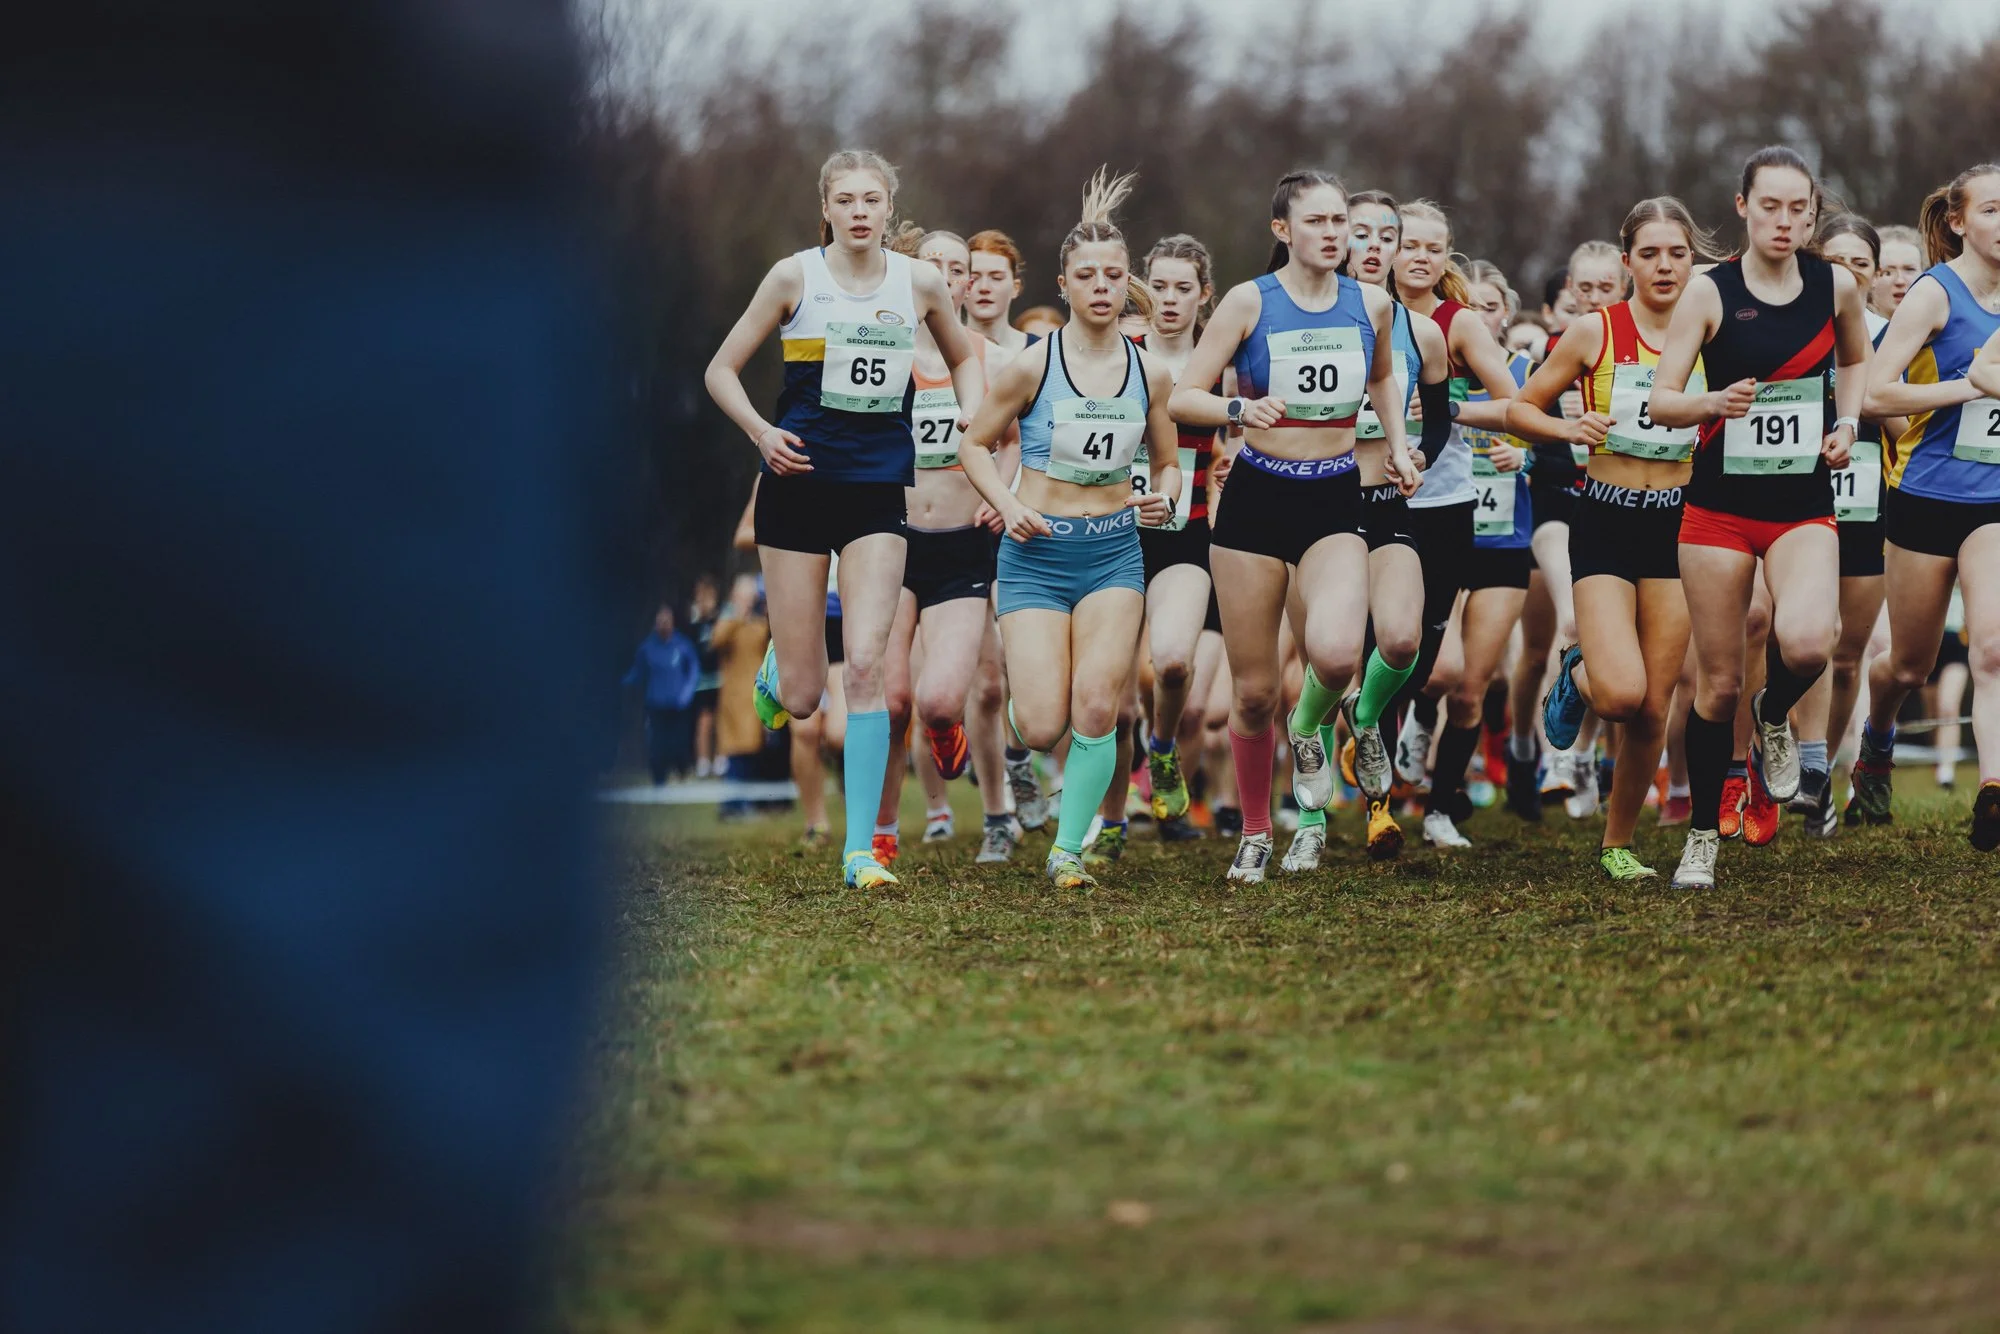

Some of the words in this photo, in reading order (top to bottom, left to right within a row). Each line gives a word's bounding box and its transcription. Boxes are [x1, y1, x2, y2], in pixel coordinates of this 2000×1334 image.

[846, 337, 896, 347] SEDGEFIELD
[1291, 343, 1343, 352] SEDGEFIELD
[850, 357, 886, 386] 65
[1298, 364, 1338, 393] 30
[1755, 394, 1802, 403] EDGEFIELD
[920, 419, 954, 444] 27
[1750, 414, 1799, 445] 191
[1082, 432, 1114, 460] 41
[1256, 456, 1313, 476] NIKE
[1588, 480, 1641, 508] NIKE
[1642, 487, 1682, 509] PRO
[1832, 472, 1855, 497] 11
[1085, 510, 1133, 535] NIKE
